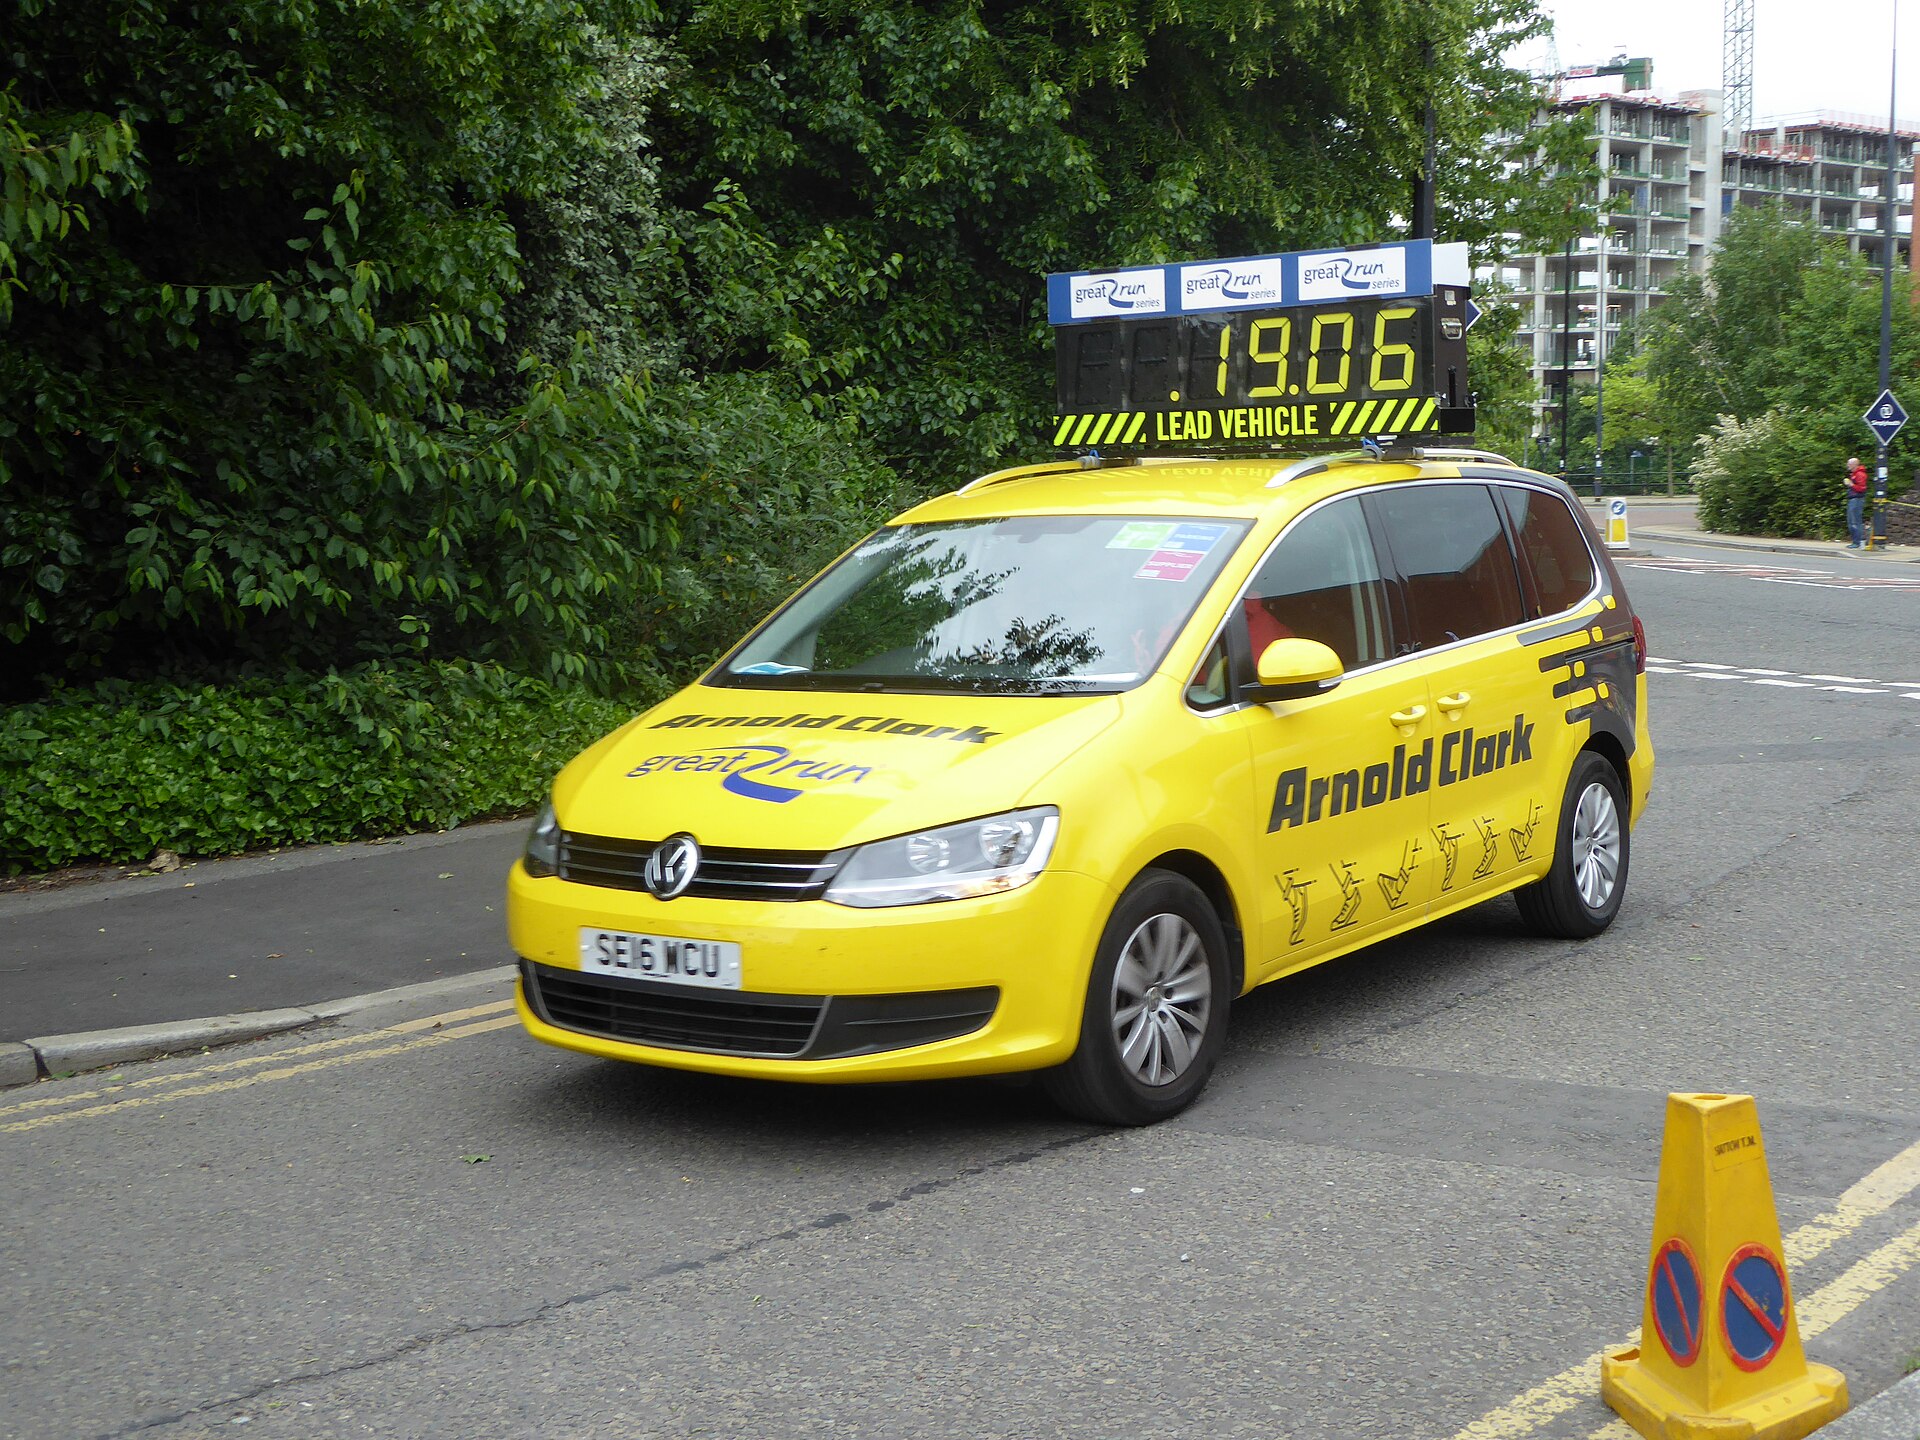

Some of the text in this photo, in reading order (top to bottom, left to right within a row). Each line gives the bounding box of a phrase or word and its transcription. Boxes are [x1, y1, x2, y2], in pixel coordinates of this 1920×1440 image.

[1186, 273, 1262, 294] great run
[1304, 261, 1384, 284] great run
[1371, 277, 1400, 289] series
[1075, 283, 1147, 303] great run
[1135, 297, 1160, 309] series
[1250, 288, 1277, 299] series
[1156, 405, 1319, 441] LEAD VEHICLE
[646, 714, 1003, 744] Arnold Clark
[626, 752, 874, 784] great run
[1266, 713, 1535, 834] Arnold Clark
[598, 933, 655, 970] SE16
